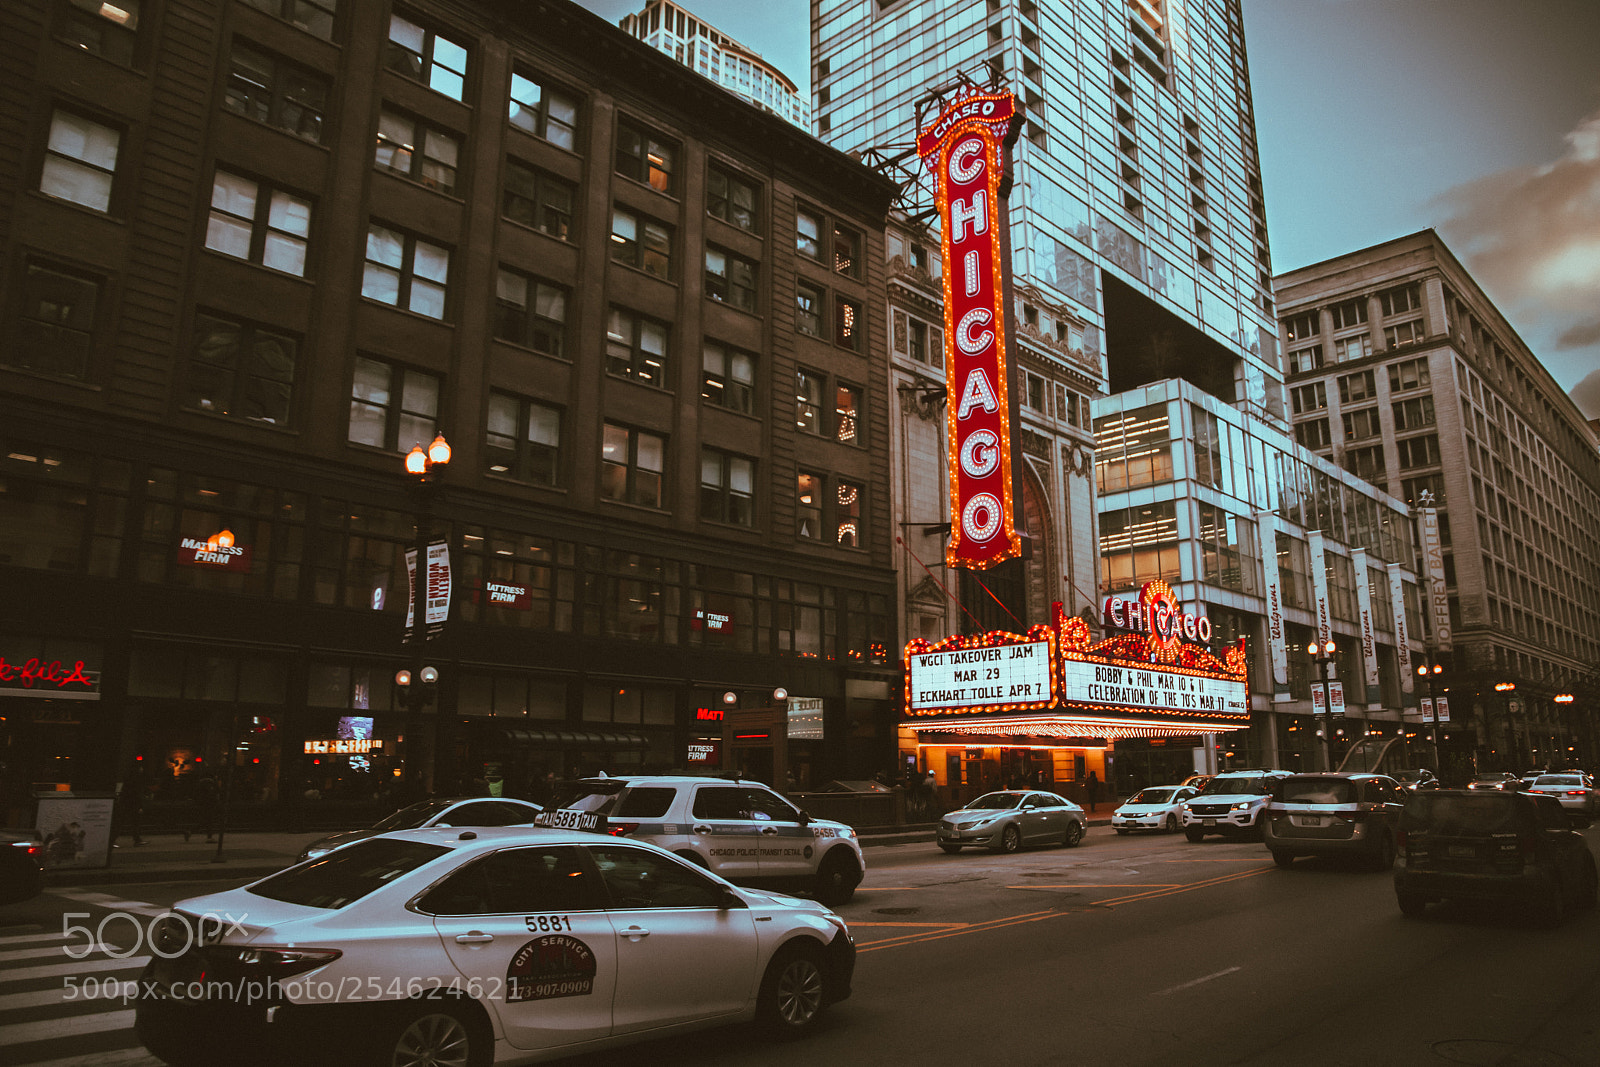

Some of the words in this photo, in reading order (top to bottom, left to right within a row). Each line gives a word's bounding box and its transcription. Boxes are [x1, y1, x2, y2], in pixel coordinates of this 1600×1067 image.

[934, 102, 980, 138] CHASE
[948, 138, 1003, 543] CHICAGO
[1423, 509, 1442, 569] BALLET
[194, 551, 230, 564] FIRM
[428, 562, 439, 599] WOMAN
[438, 565, 450, 598] PRETTY
[491, 592, 516, 603] FIRM
[696, 611, 729, 622] MTTRESS
[708, 620, 723, 629] IRM
[1110, 597, 1211, 642] CHICAGO
[1269, 583, 1282, 640] Walgreens
[1431, 575, 1452, 650] JOFFREY
[1362, 609, 1373, 658] Walgreens
[1398, 621, 1409, 666] Walgreens
[920, 655, 943, 667] WGCI
[948, 649, 1001, 665] TAKEOVER
[1009, 645, 1033, 659] JAM
[954, 669, 977, 682] MAR
[986, 667, 1000, 680] 29
[1095, 666, 1123, 684] BOBBY
[1137, 671, 1154, 688] PHIL
[1158, 674, 1175, 690] MAR
[1178, 676, 1186, 691] 10
[1198, 679, 1204, 693] 11
[920, 688, 966, 703] ECKHART
[972, 686, 1003, 700] TOLLE
[1009, 684, 1031, 697] APR
[1035, 683, 1042, 695] 7
[1088, 683, 1145, 704] CELEBRATION
[1149, 689, 1158, 705] OF
[1163, 691, 1177, 707] THE
[1199, 694, 1215, 710] MAR
[1217, 696, 1224, 710] 17
[688, 751, 707, 760] FIRM
[554, 811, 583, 828] 5881
[581, 813, 599, 829] TAXI
[709, 848, 736, 857] CHICAGO
[736, 848, 757, 857] POLICE
[760, 848, 782, 857] TRANSIT
[784, 848, 802, 857] DETAIL
[525, 915, 572, 932] 5881
[515, 945, 534, 967] CITY
[541, 937, 589, 960] SERVICE
